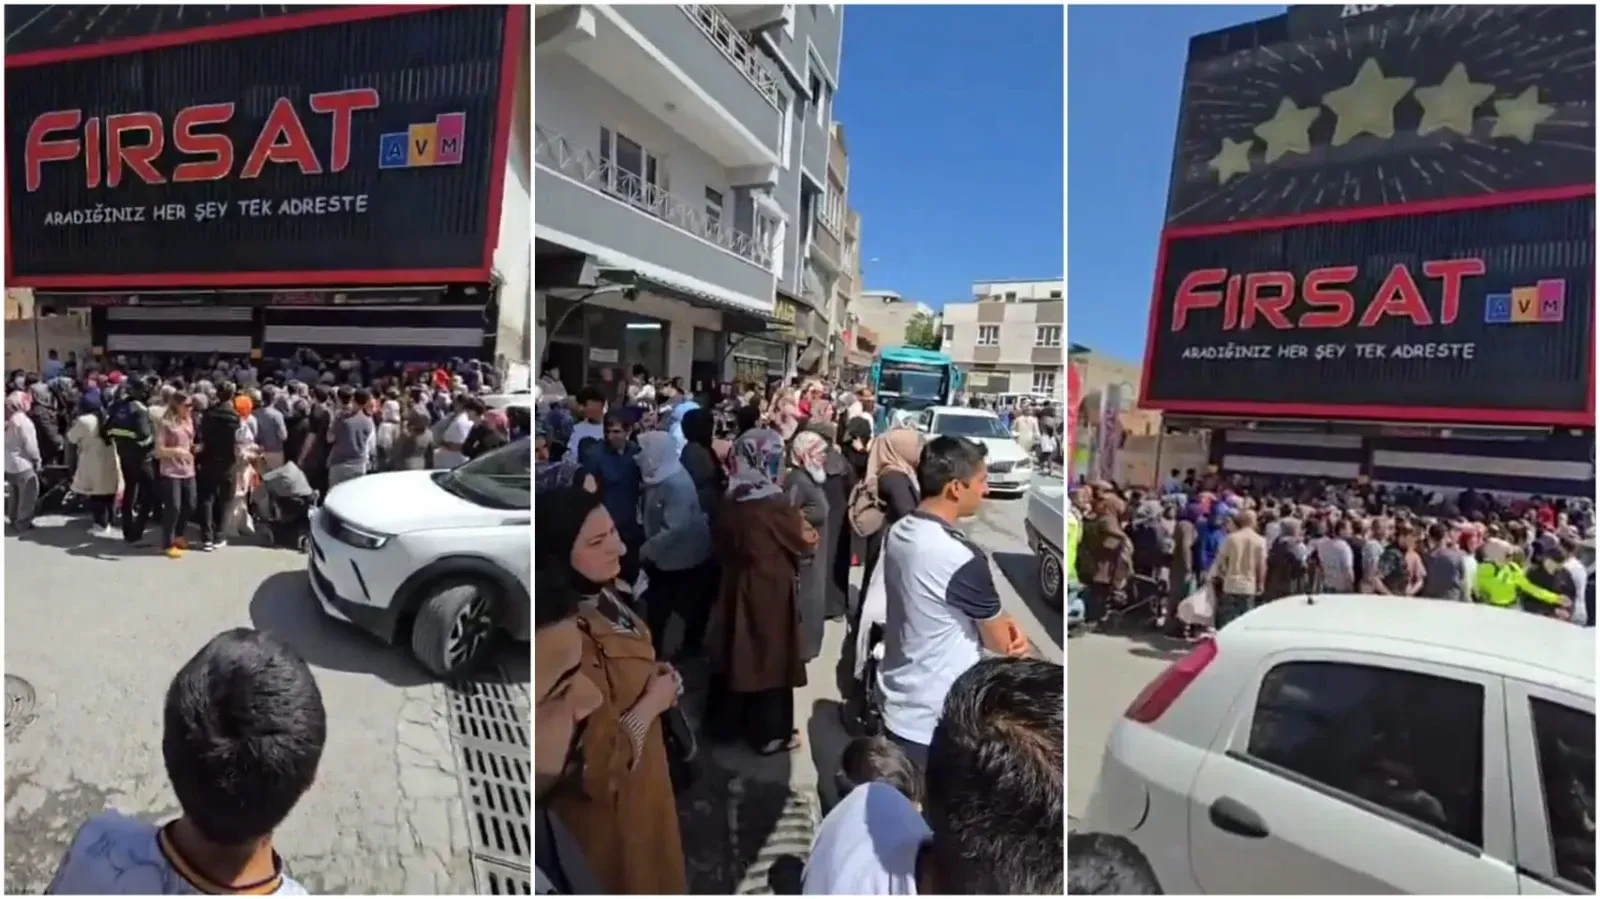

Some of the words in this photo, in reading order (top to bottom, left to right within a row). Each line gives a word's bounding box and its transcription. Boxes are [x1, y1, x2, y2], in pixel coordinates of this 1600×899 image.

[25, 88, 379, 192] FIRSAT
[44, 203, 145, 226] ARADIĞINIZ
[153, 204, 186, 221] HER
[194, 202, 228, 222] ŞEY
[238, 199, 272, 217] TEK
[279, 194, 368, 215] ADRESTE
[1171, 258, 1484, 333] FIRSAT
[1182, 341, 1271, 360] ARADIĞINIZ
[1277, 344, 1308, 359] HER
[1314, 344, 1346, 361] ŞEY
[1355, 343, 1387, 358] TEK
[1390, 342, 1476, 360] ADRESTE
